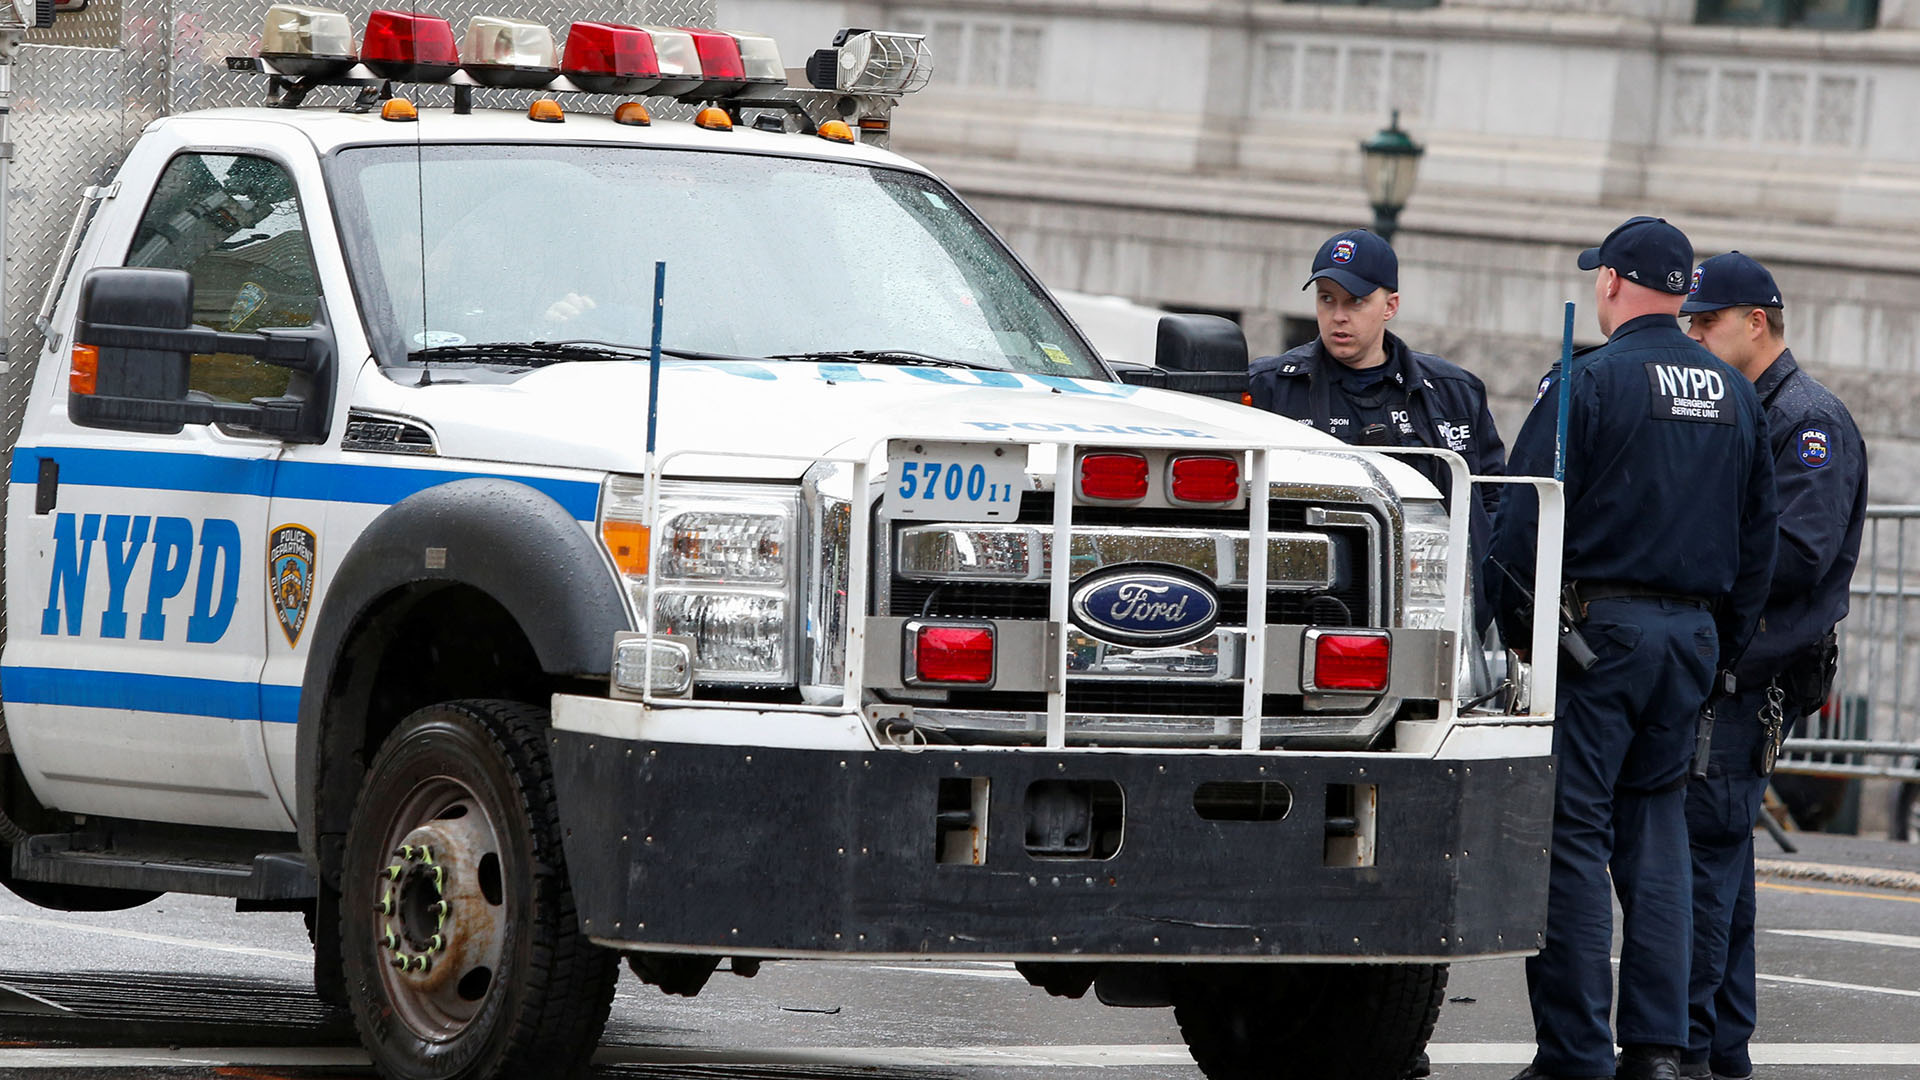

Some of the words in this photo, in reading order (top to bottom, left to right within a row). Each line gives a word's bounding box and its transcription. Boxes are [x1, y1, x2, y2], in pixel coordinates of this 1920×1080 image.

[1655, 364, 1725, 400] NYPD
[1671, 406, 1702, 417] SERVICE
[1702, 409, 1720, 418] UNIT
[1673, 397, 1716, 409] EMERGENCY
[961, 422, 1218, 438] POLICE
[1802, 431, 1827, 443] POLICE
[899, 462, 985, 501] 5700
[988, 484, 1011, 502] 11
[280, 530, 306, 545] POLICE
[271, 542, 313, 564] DEPARTMENT
[41, 512, 241, 644] NYPD
[303, 572, 313, 602] YORK
[271, 577, 281, 604] CITY
[1111, 583, 1189, 622] Ford
